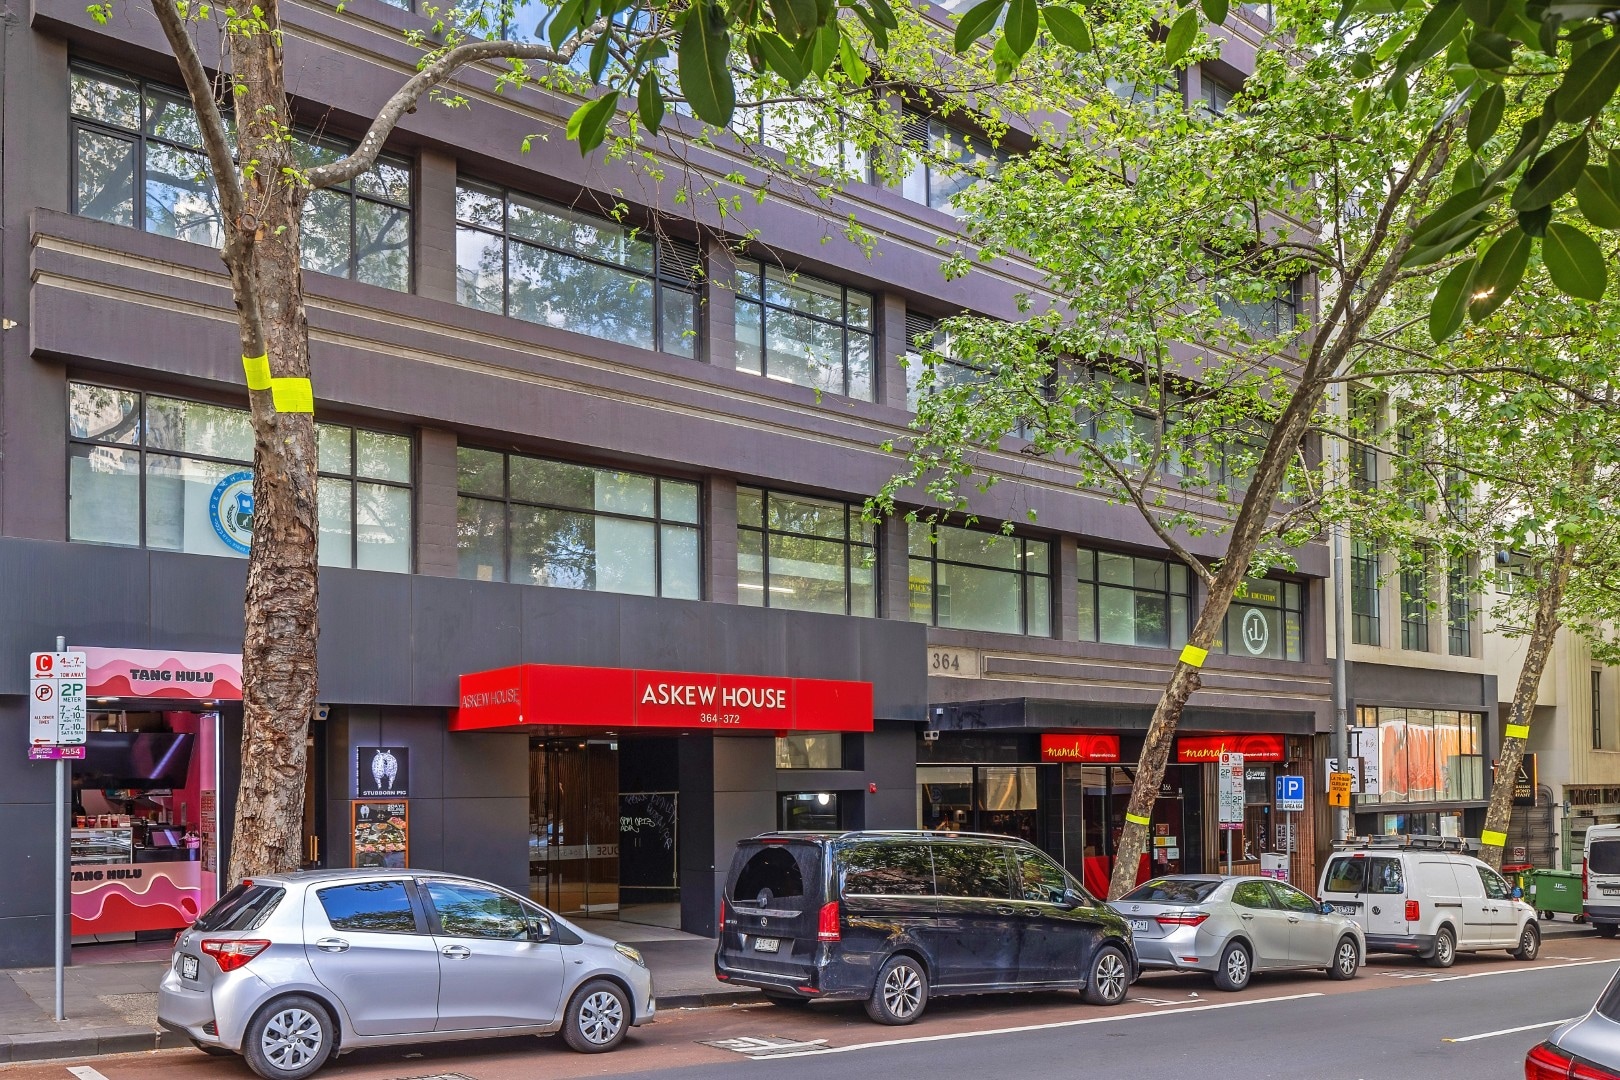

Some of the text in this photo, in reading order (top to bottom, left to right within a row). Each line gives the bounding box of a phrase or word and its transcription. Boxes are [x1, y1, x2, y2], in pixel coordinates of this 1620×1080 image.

[932, 652, 960, 671] 364
[129, 668, 214, 683] TANG HULU
[61, 683, 83, 696] 2P
[641, 683, 786, 709] ASKEW HOUSE
[462, 687, 520, 709] ASKEW HOUSE
[700, 713, 740, 724] 364-372
[1043, 741, 1086, 758] mamak
[1180, 742, 1227, 758] mamak
[1220, 768, 1231, 776] 2P
[1288, 780, 1299, 796] P
[1232, 795, 1243, 803] 2P
[106, 868, 142, 880] HULU
